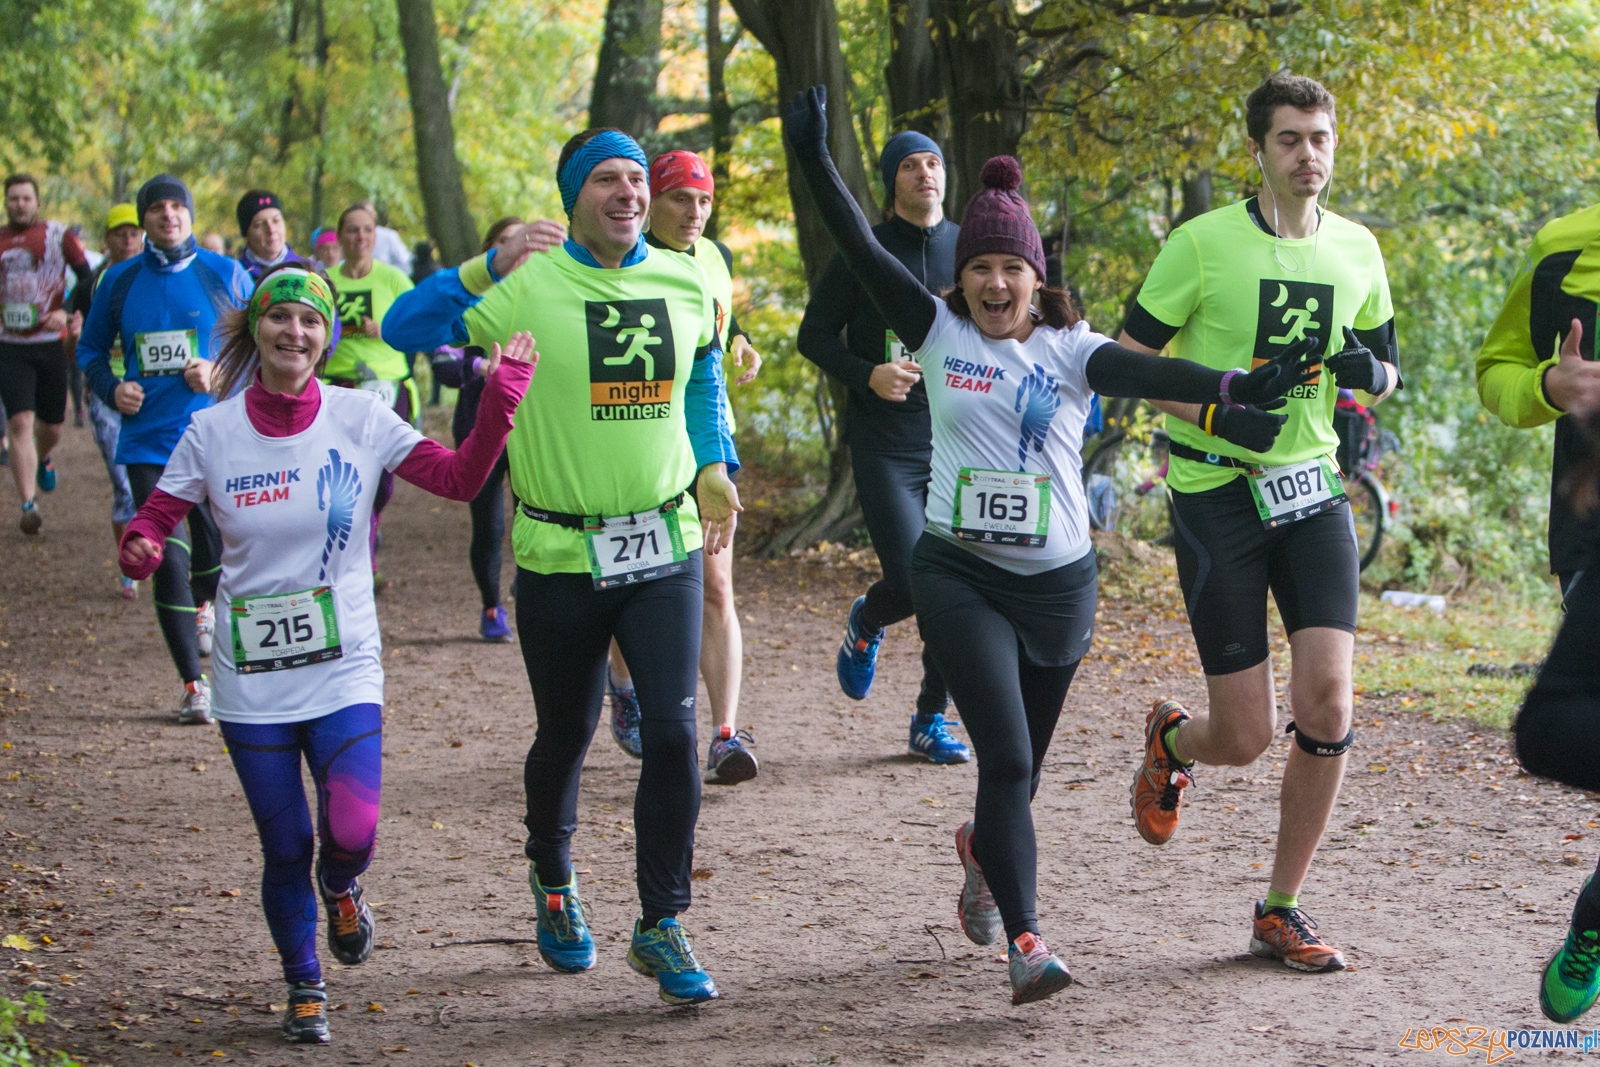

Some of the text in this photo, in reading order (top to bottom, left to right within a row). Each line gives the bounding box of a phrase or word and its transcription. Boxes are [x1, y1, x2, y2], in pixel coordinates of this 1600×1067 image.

[148, 344, 186, 362] 994
[943, 356, 1006, 380] HERNIK
[609, 381, 661, 403] night
[945, 373, 993, 394] TEAM
[592, 403, 670, 420] runners
[225, 468, 301, 493] HERNIK
[1264, 466, 1321, 505] 1087
[233, 486, 289, 509] TEAM
[976, 492, 1028, 522] 163
[983, 522, 1017, 531] EWELINA
[609, 529, 660, 563] 271
[626, 560, 651, 571] COOBA
[255, 613, 313, 648] 215
[271, 646, 306, 658] TORPEDA
[681, 696, 695, 708] 4F
